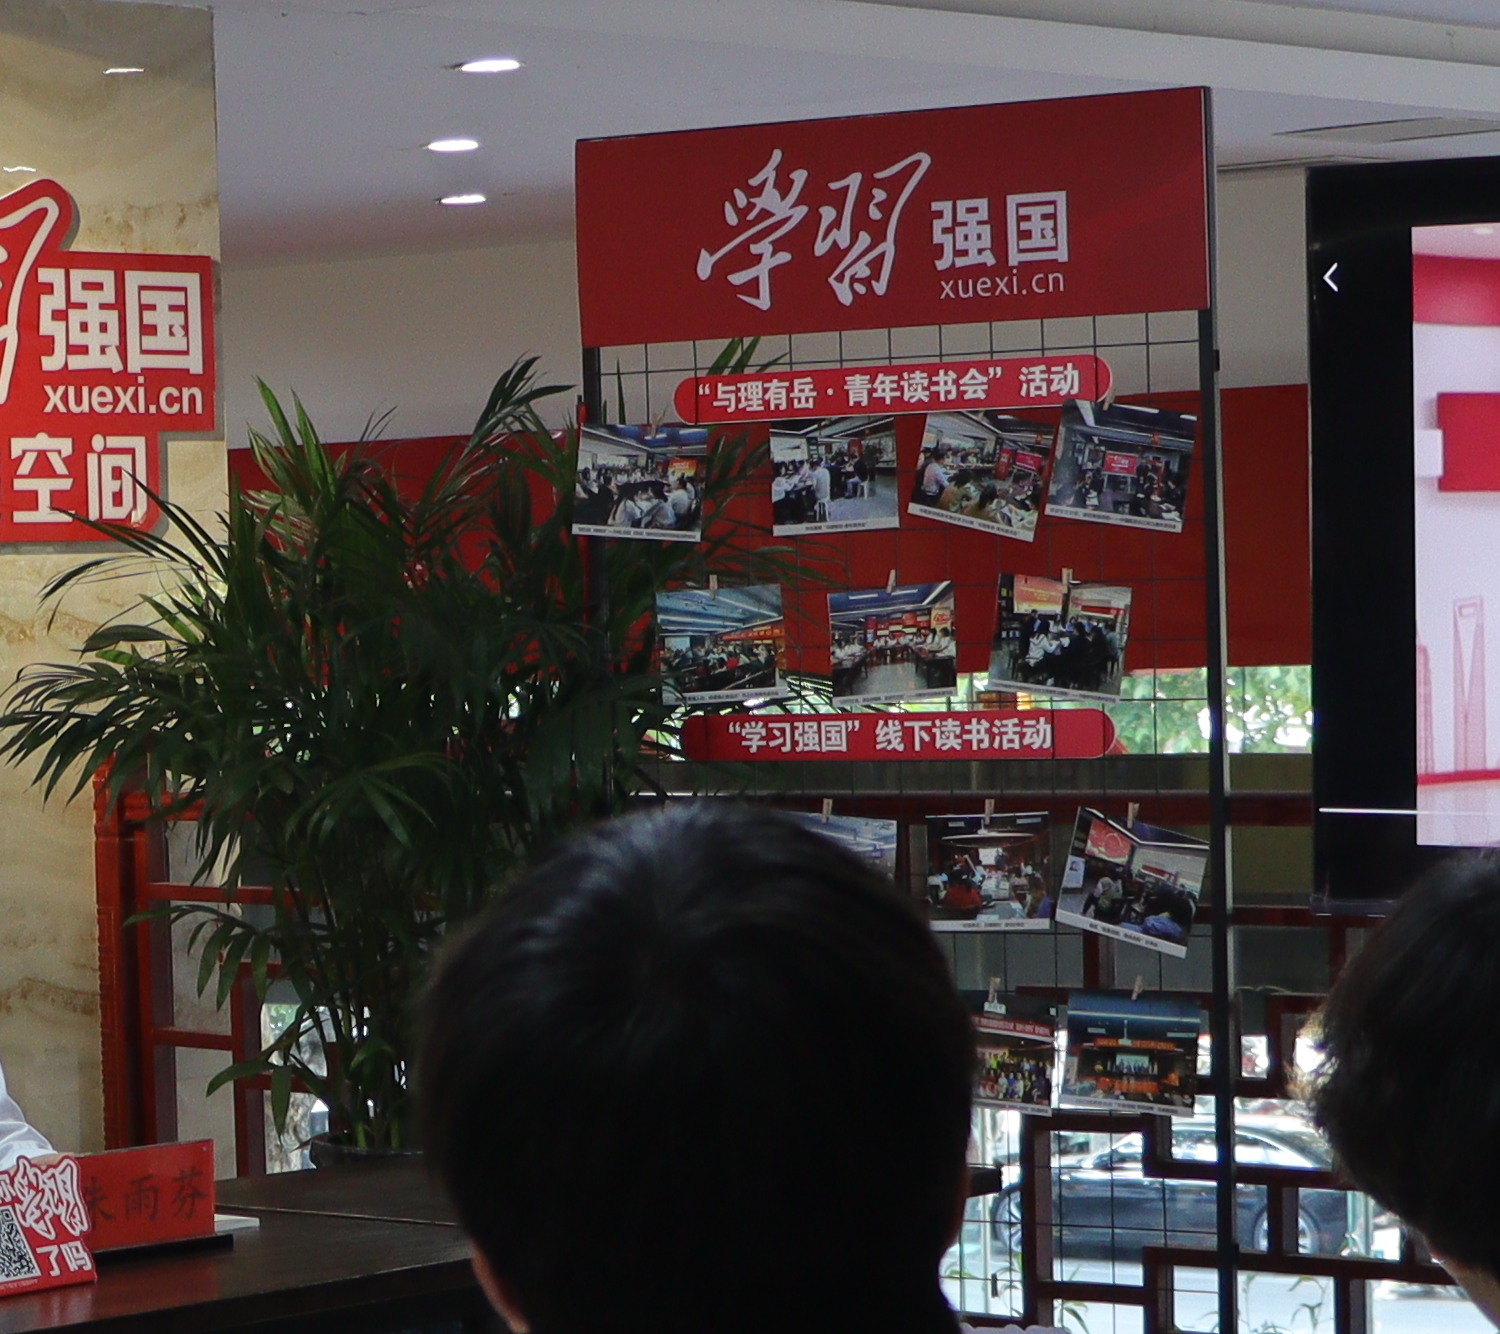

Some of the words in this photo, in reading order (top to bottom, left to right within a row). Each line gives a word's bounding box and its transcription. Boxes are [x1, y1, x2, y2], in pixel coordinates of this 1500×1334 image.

[939, 267, 1065, 300] xuexi.cn
[43, 376, 203, 415] xuexi.cn
[1018, 361, 1081, 400] 活动
[727, 720, 861, 753] “学习强国”
[875, 714, 1053, 753] 线下读书活动
[36, 1241, 93, 1277] 了吗
